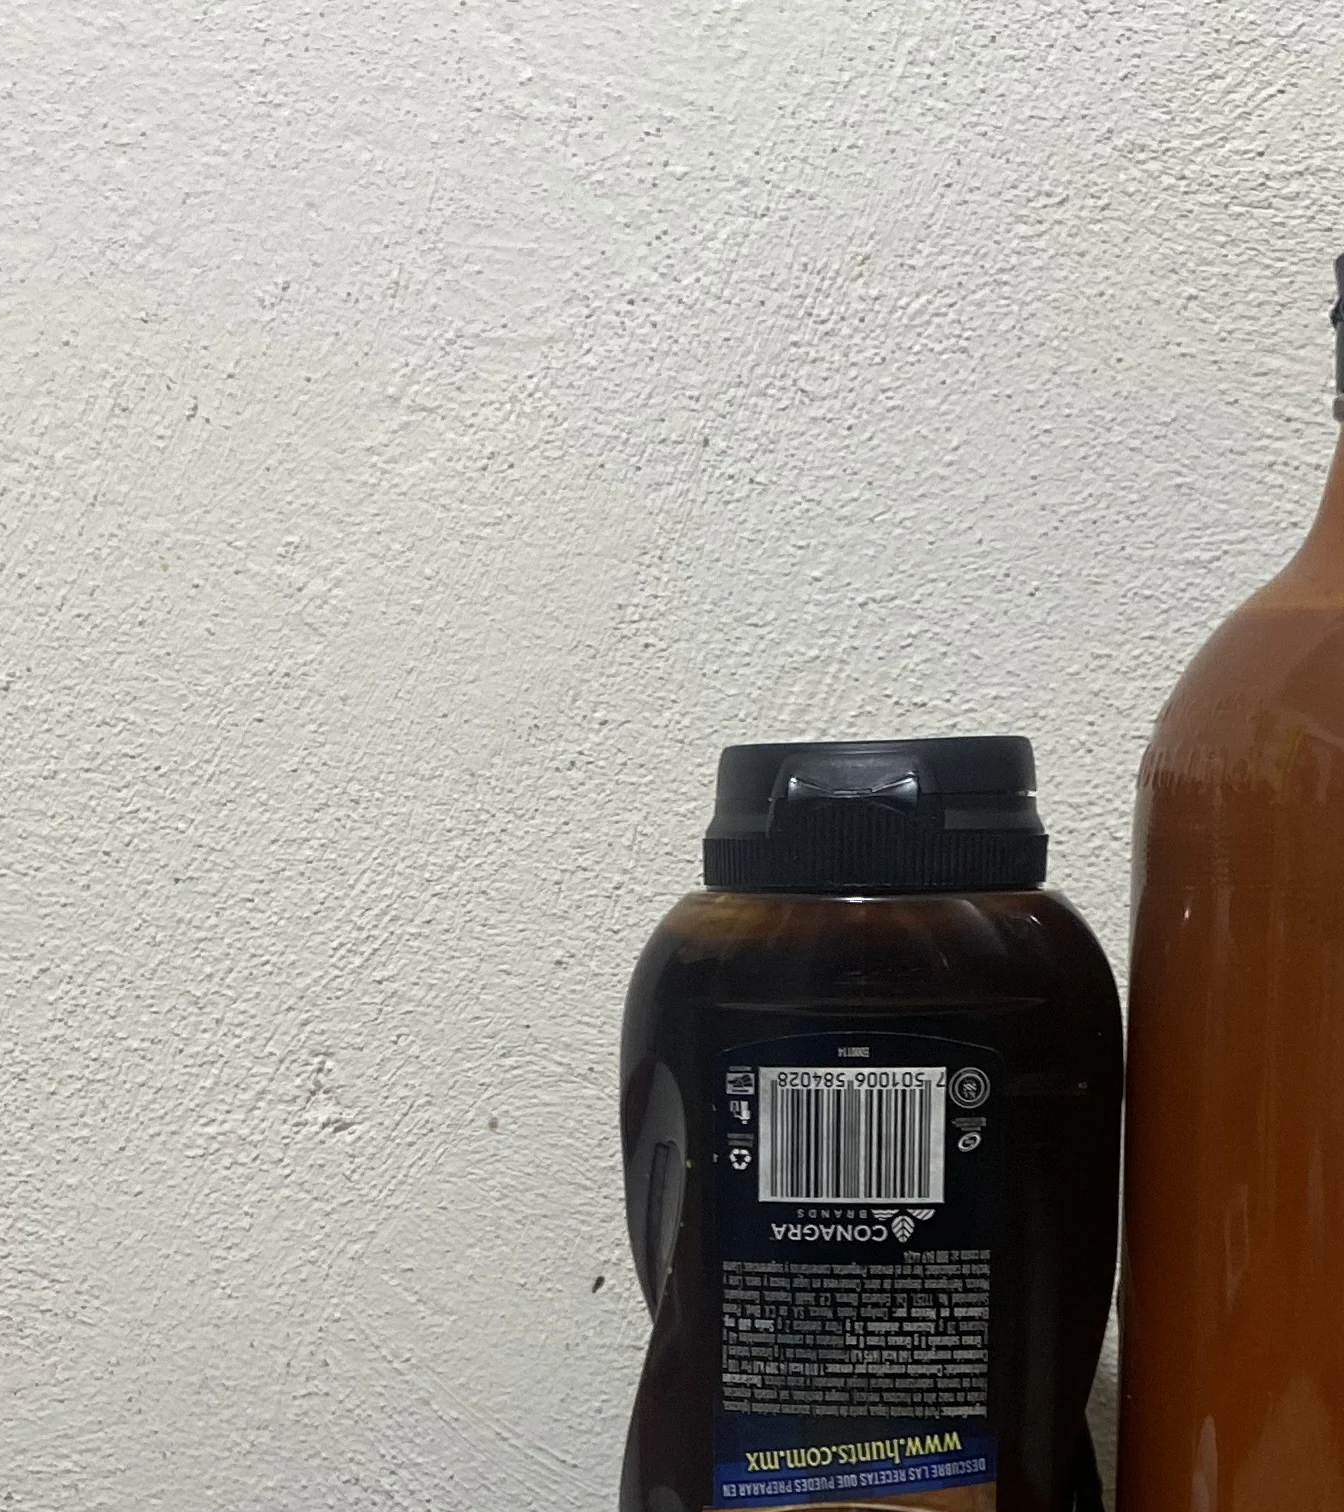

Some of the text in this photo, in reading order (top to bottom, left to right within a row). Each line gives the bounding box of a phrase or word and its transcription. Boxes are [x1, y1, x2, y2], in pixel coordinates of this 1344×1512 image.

[777, 1071, 946, 1088] 7 501006 584028
[796, 1209, 867, 1219] BRANDS
[771, 1223, 888, 1242] CONAGRA
[746, 1431, 962, 1473] www.hunts.com.mx
[722, 1458, 986, 1497] DESCUBRE LAS RECETAS QUE PUEDES PREPARAR EN
